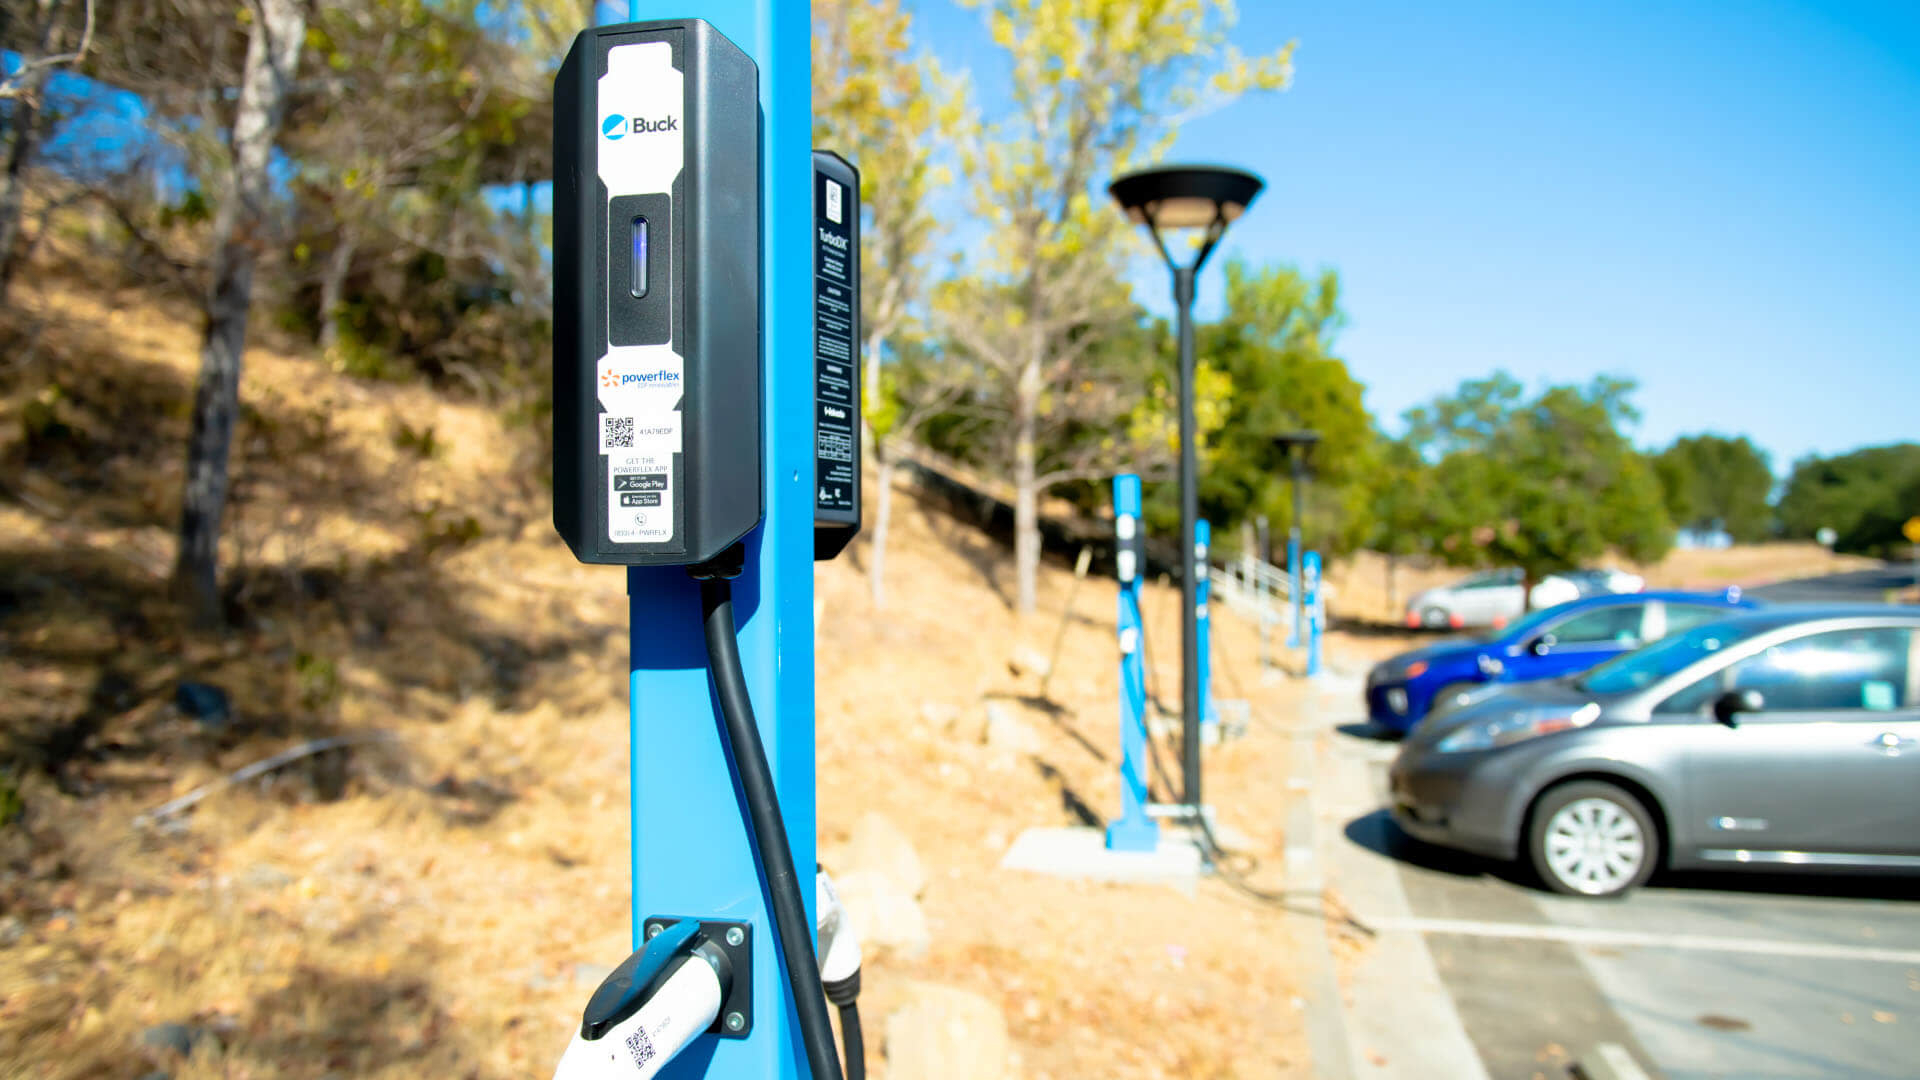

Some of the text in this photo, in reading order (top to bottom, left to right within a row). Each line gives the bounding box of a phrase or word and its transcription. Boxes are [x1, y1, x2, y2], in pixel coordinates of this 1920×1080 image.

[633, 115, 678, 133] Buck
[622, 370, 680, 385] powerflex
[626, 457, 655, 465] GET THE
[613, 465, 668, 474] POWERFLEX APP
[629, 480, 665, 489] Google Play
